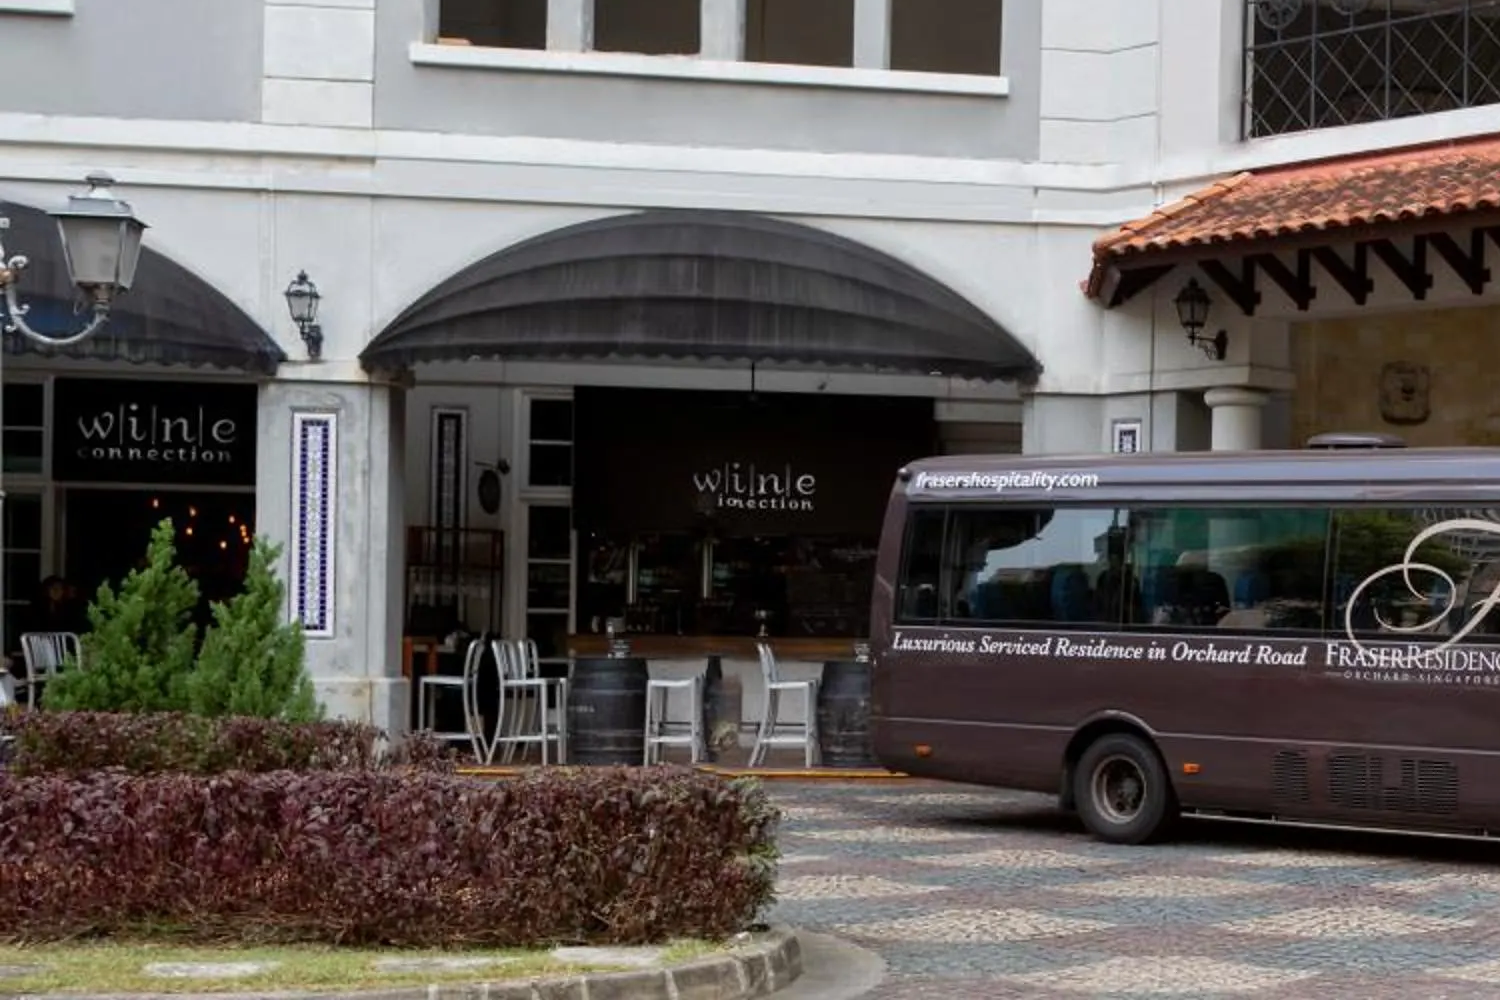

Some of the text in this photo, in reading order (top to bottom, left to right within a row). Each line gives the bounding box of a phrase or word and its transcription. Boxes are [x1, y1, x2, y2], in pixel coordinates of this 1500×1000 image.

[77, 446, 232, 462] connection
[915, 471, 1099, 493] frasershospitality.com
[892, 631, 1308, 666] Luxurious Serviced Residence in Orchard Road
